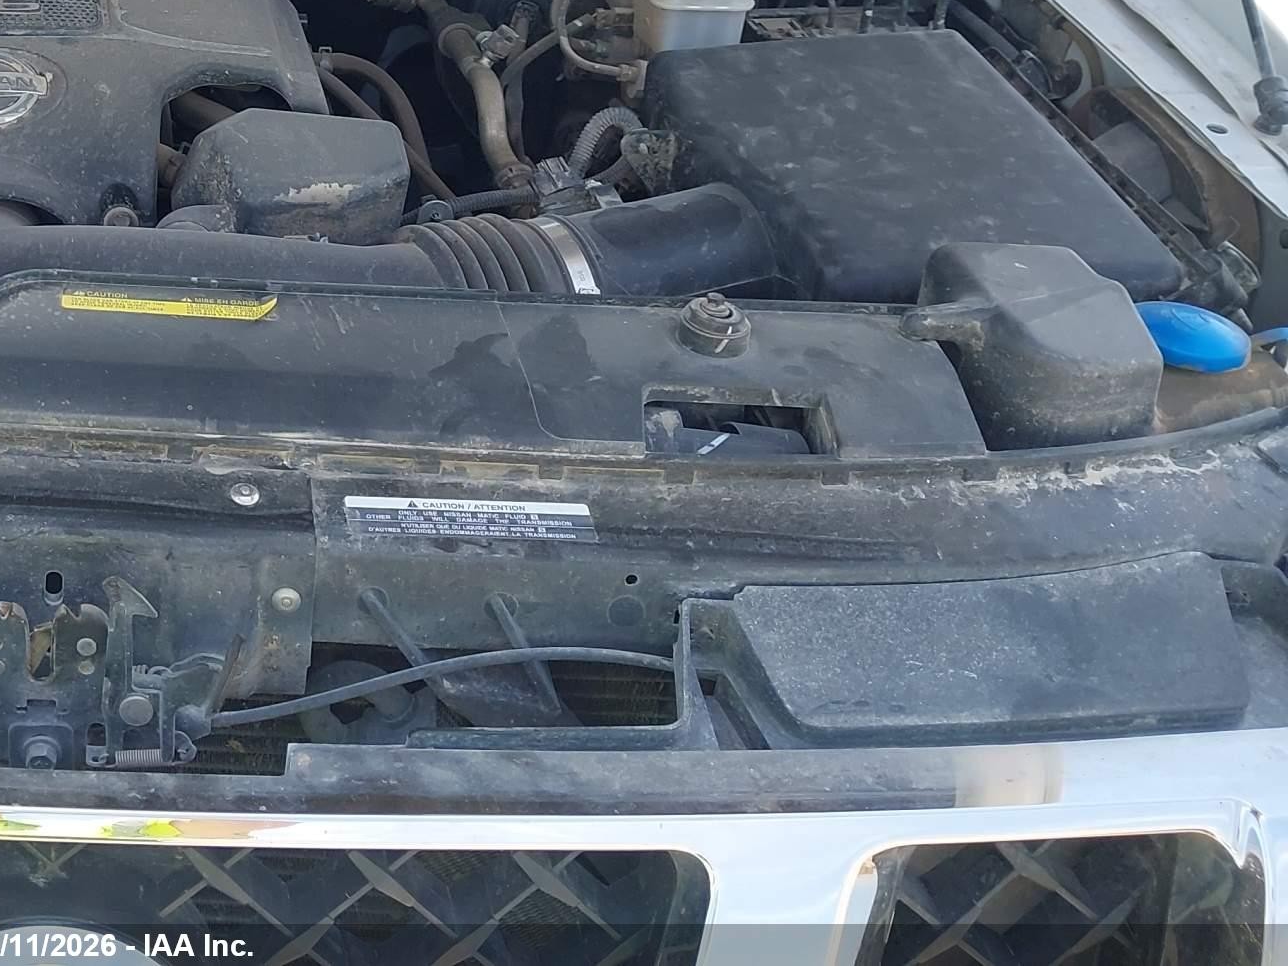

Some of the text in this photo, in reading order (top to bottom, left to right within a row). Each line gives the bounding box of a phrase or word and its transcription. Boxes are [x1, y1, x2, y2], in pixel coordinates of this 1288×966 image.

[86, 290, 128, 298] CAUTION
[422, 501, 465, 510] CAUTION
[473, 503, 526, 512] ATTENTION
